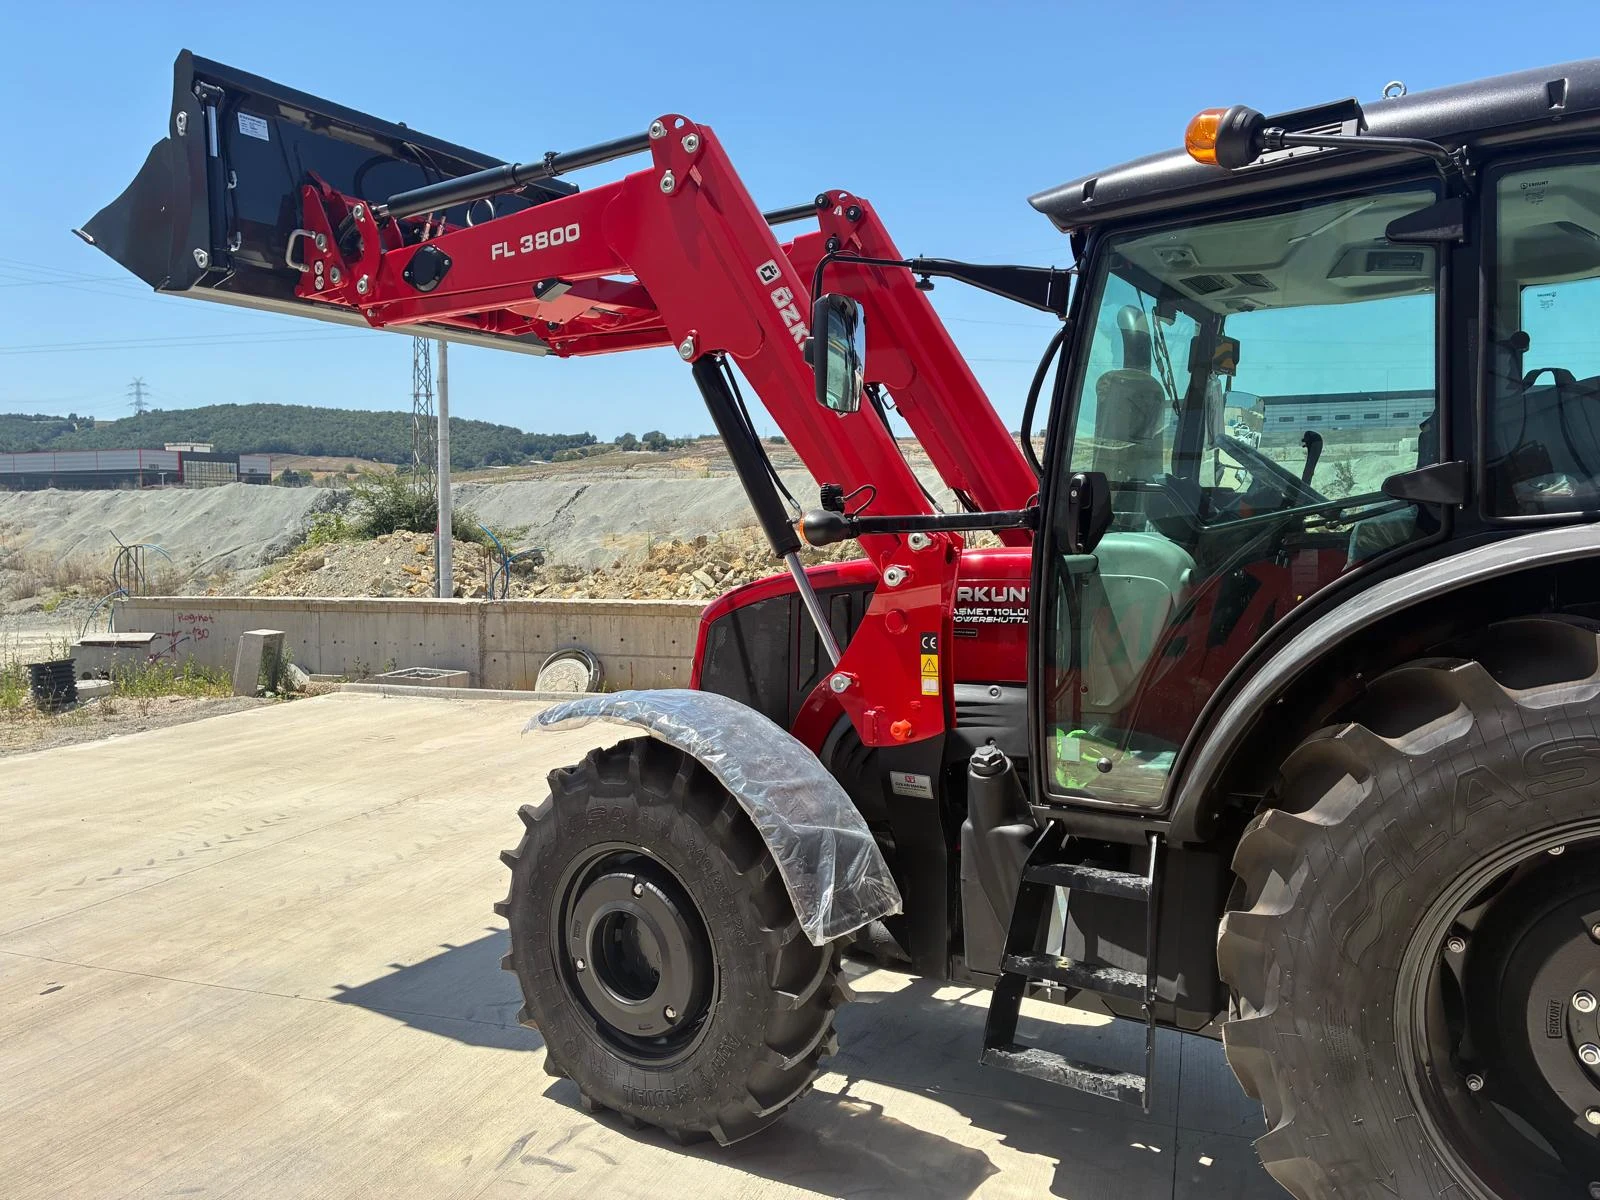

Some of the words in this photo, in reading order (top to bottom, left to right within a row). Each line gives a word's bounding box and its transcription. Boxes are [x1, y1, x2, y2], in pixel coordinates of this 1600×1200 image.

[491, 241, 516, 261] FL
[519, 222, 581, 254] 3800
[770, 286, 810, 351] ÖZK
[957, 586, 1030, 602] RKUN
[921, 636, 937, 649] CE
